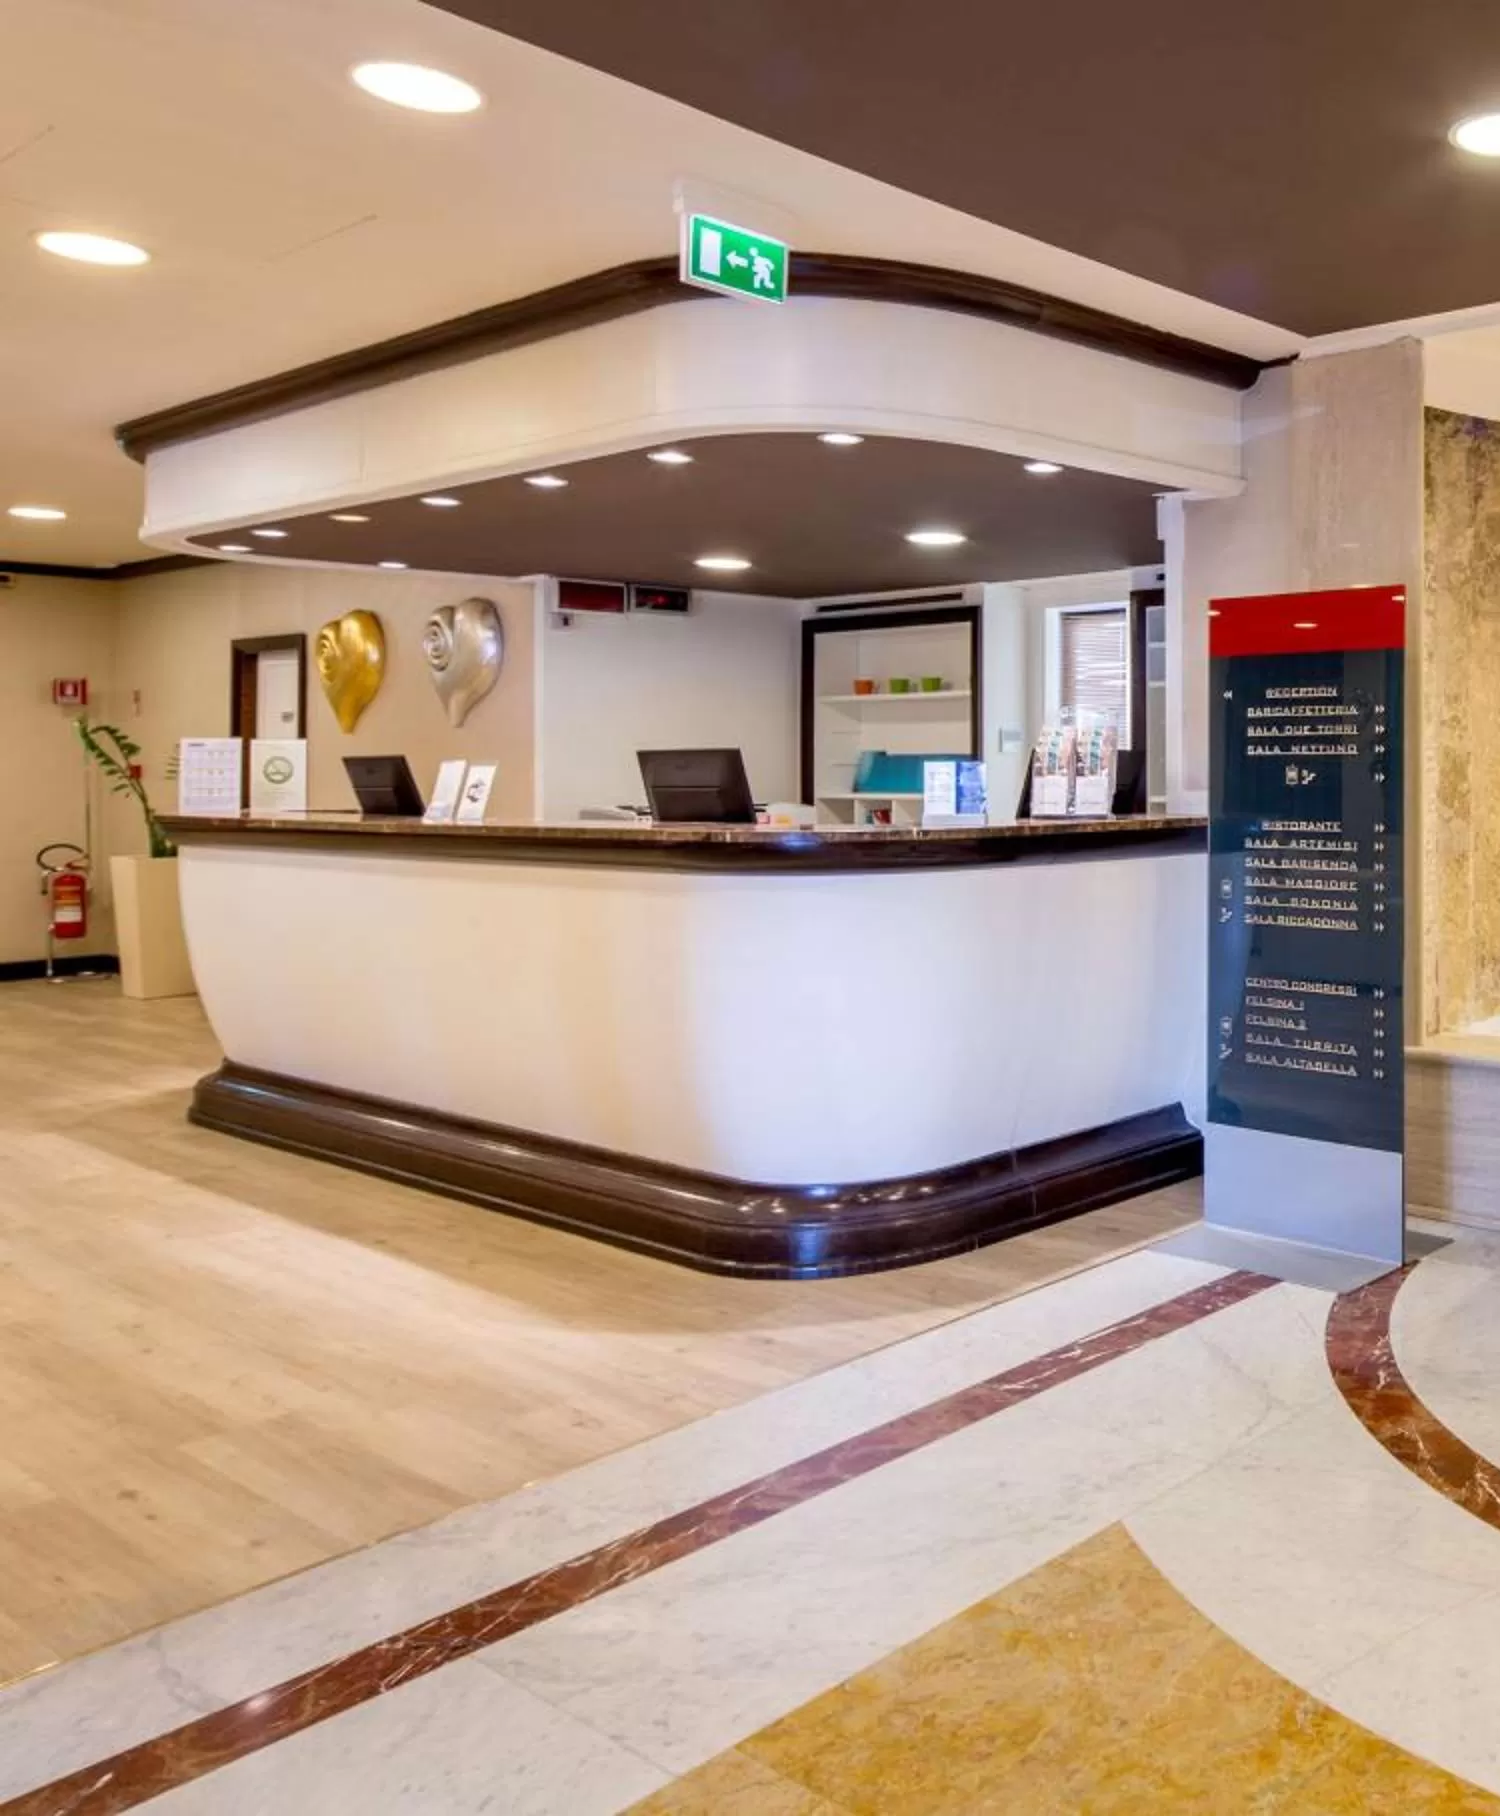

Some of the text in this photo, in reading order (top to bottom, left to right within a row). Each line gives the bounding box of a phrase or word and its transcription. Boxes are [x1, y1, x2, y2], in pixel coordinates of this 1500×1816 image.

[1266, 687, 1337, 699] RECEPTION
[1248, 726, 1278, 736] SALA
[1248, 744, 1358, 755] SALA NETTUNO
[1262, 821, 1342, 832] RISTORANTE
[1245, 838, 1279, 849] SALA
[1245, 857, 1276, 868] SALA
[1245, 876, 1358, 891] SALA MAGGIORE
[1245, 895, 1279, 906] SALA
[1245, 915, 1275, 925] SALA
[1245, 978, 1358, 996] CENTRO CONGRESSI
[1245, 1032, 1282, 1046] SALA
[1245, 1052, 1279, 1067] SALA
